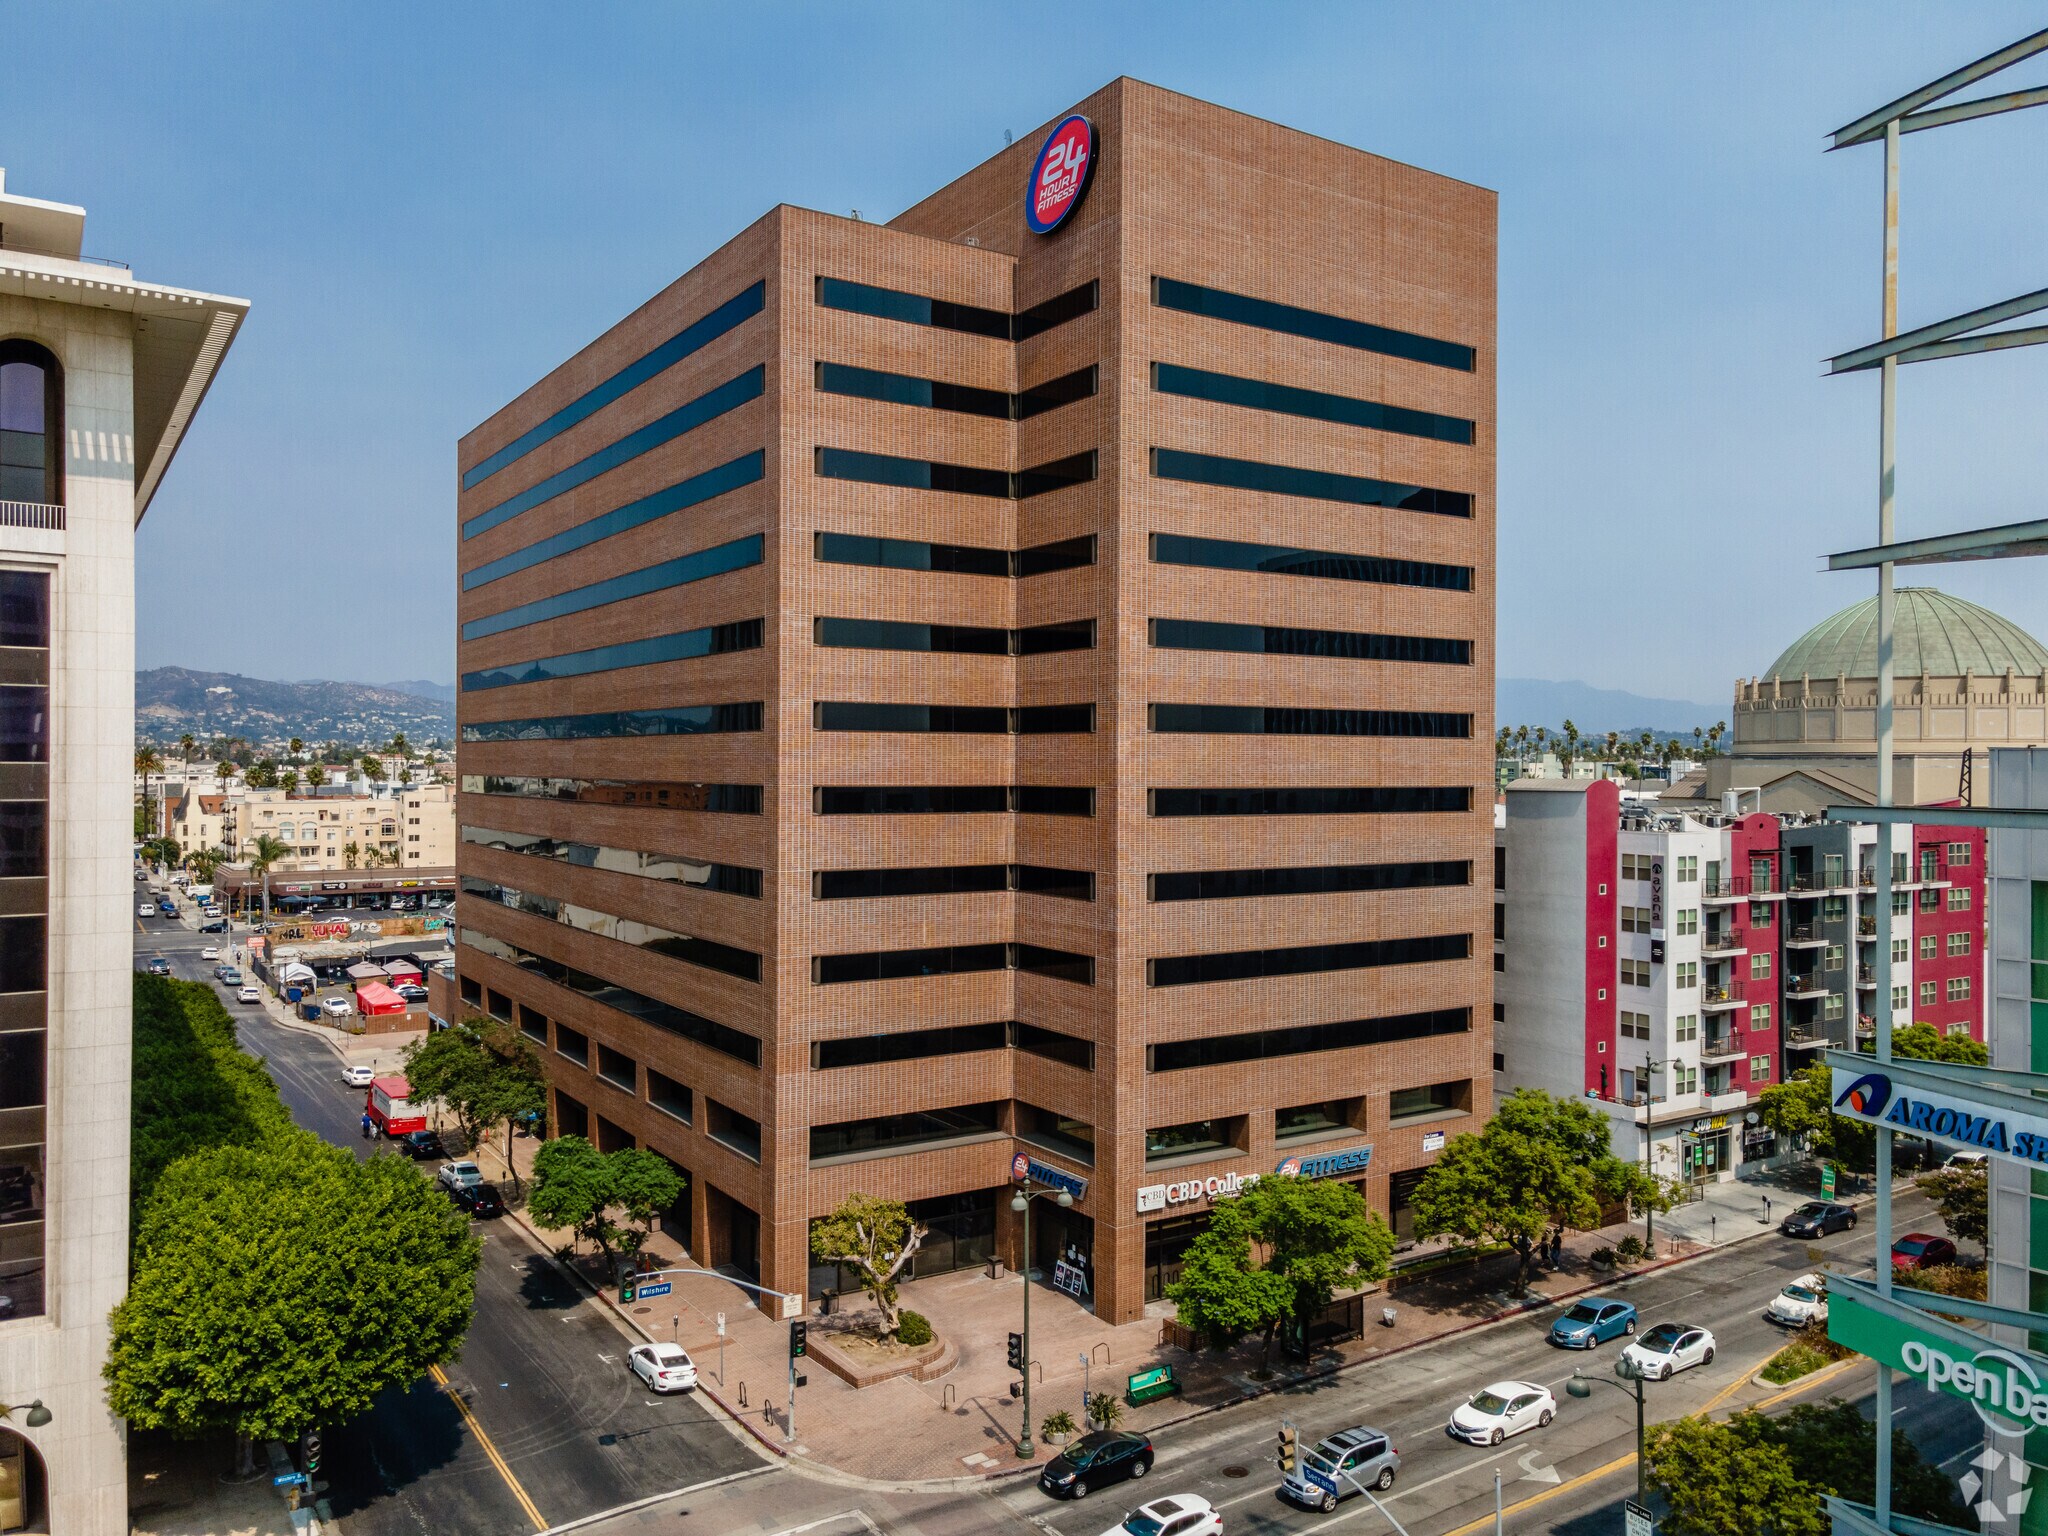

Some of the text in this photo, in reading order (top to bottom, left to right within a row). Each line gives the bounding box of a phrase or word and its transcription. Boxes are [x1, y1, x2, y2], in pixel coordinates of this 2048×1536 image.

[1042, 136, 1087, 186] 24
[1036, 183, 1077, 214] FITNESS
[1039, 174, 1071, 202] HOUR
[1652, 876, 1661, 921] avana
[1693, 1115, 1728, 1133] SUBWAY
[1885, 1097, 2048, 1165] AROMA SP
[1015, 1157, 1084, 1197] 24 FITNESS
[1281, 1149, 1371, 1179] 24 FITNESS
[1147, 1189, 1165, 1201] CBD
[1166, 1179, 1203, 1204] CBD
[1205, 1171, 1261, 1196] Collee
[641, 1285, 669, 1296] Wilshire
[1306, 1469, 1335, 1492] Serrano
[1629, 1513, 1649, 1528] BUSES
